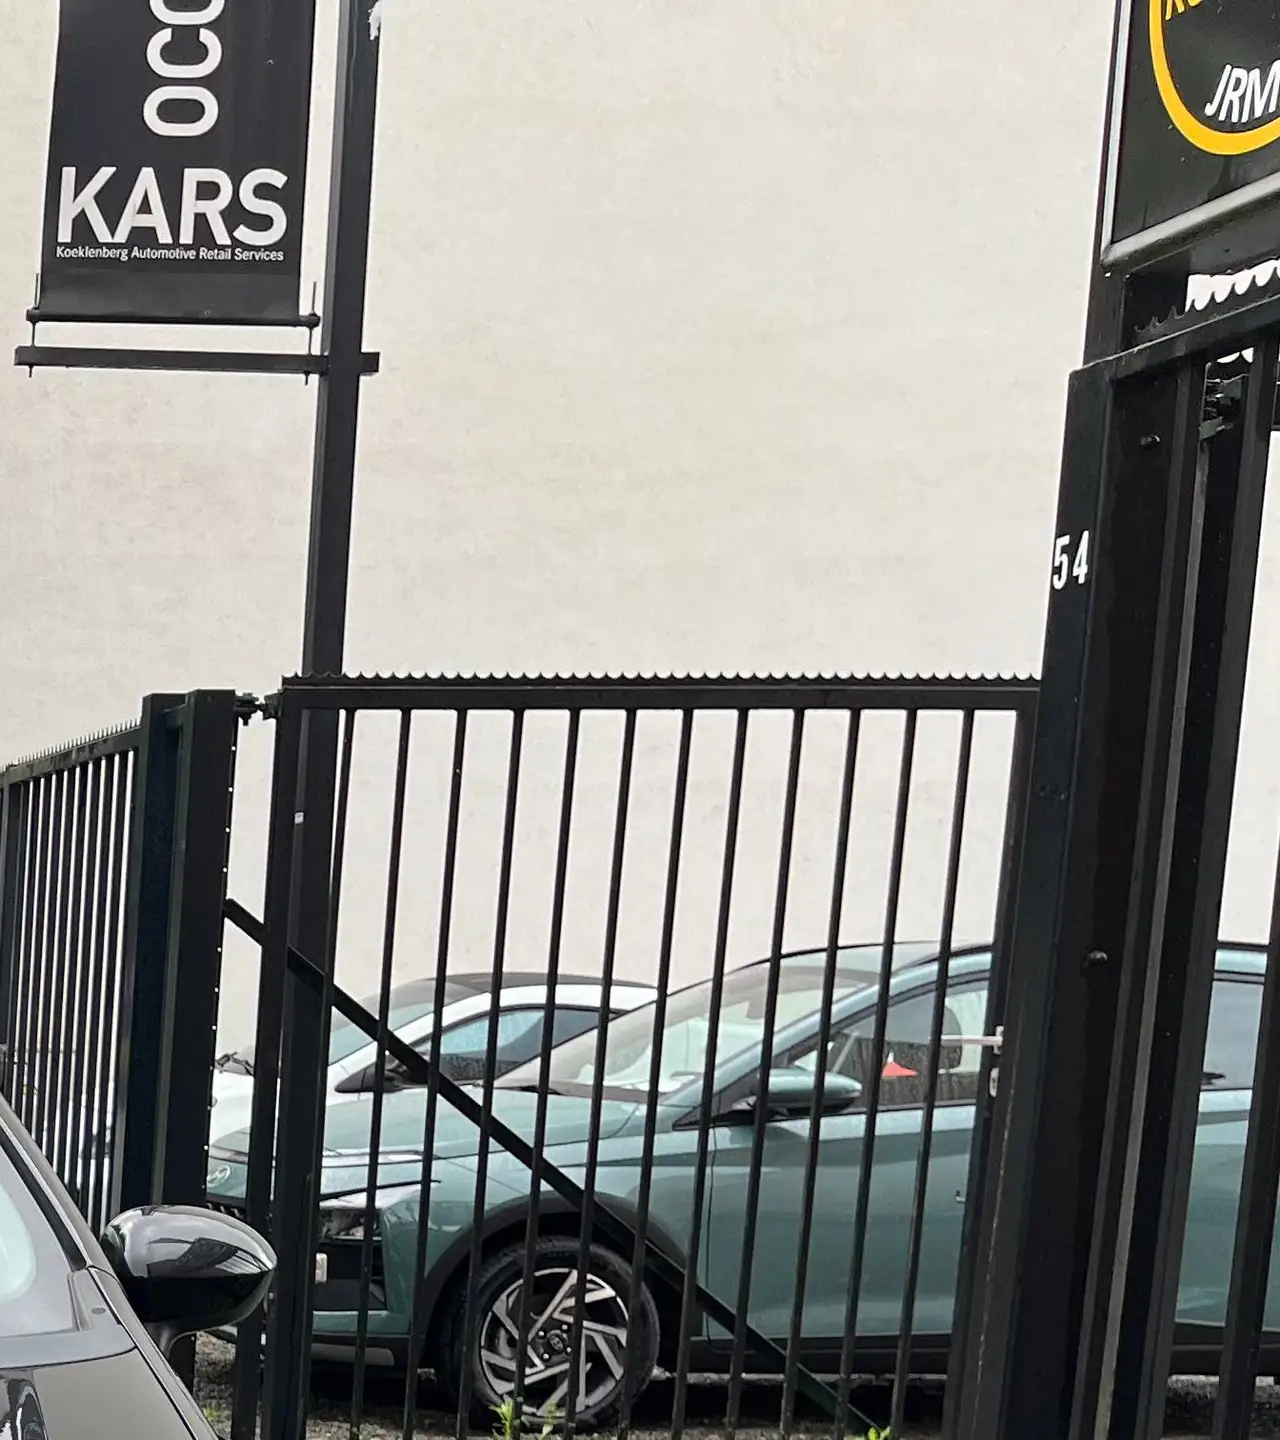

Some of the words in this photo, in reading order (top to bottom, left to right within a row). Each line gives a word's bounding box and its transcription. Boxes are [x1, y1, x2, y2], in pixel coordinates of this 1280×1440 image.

[57, 166, 288, 246] KARS
[56, 246, 128, 261] Koeklenberg
[131, 247, 196, 260] Automotive
[199, 247, 231, 260] Retail
[234, 248, 284, 261] Services
[1052, 530, 1089, 590] 54
